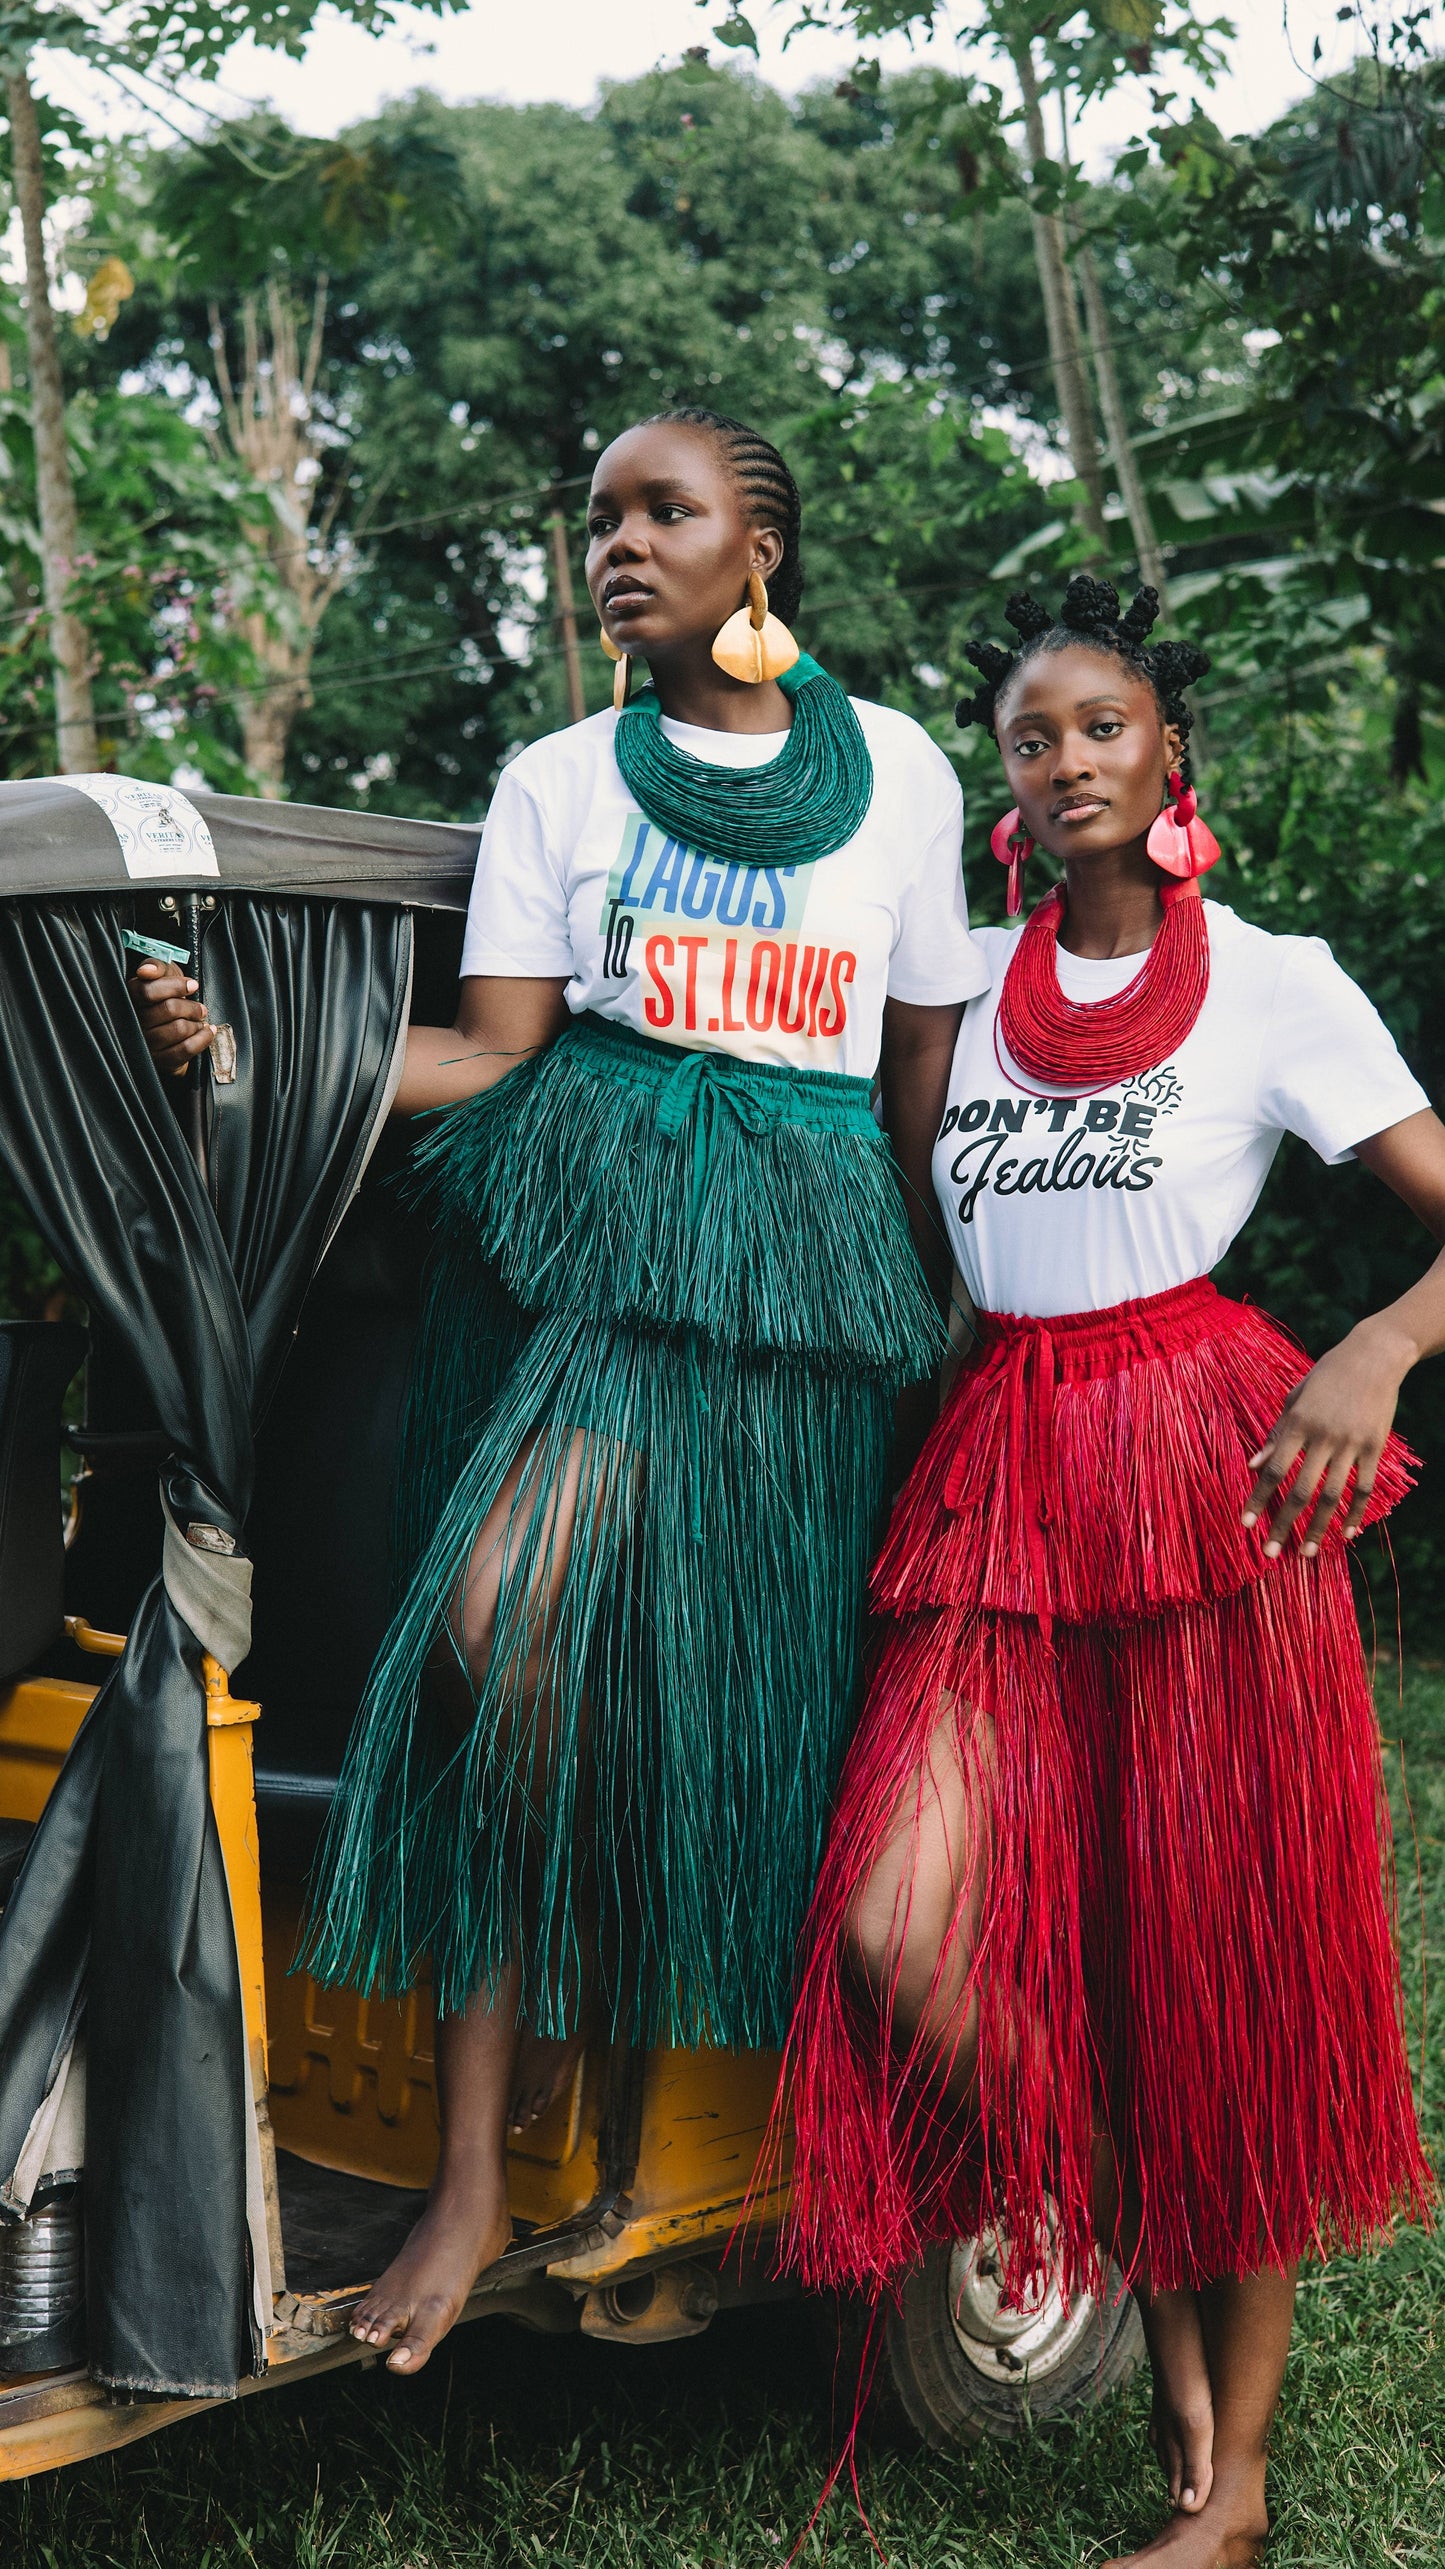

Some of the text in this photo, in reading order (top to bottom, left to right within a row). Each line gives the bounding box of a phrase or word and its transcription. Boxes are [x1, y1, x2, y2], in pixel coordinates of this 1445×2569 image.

[619, 822, 797, 936] LAGOS
[937, 1099, 1158, 1143] DON'T BE
[950, 1126, 1163, 1224] Jealous
